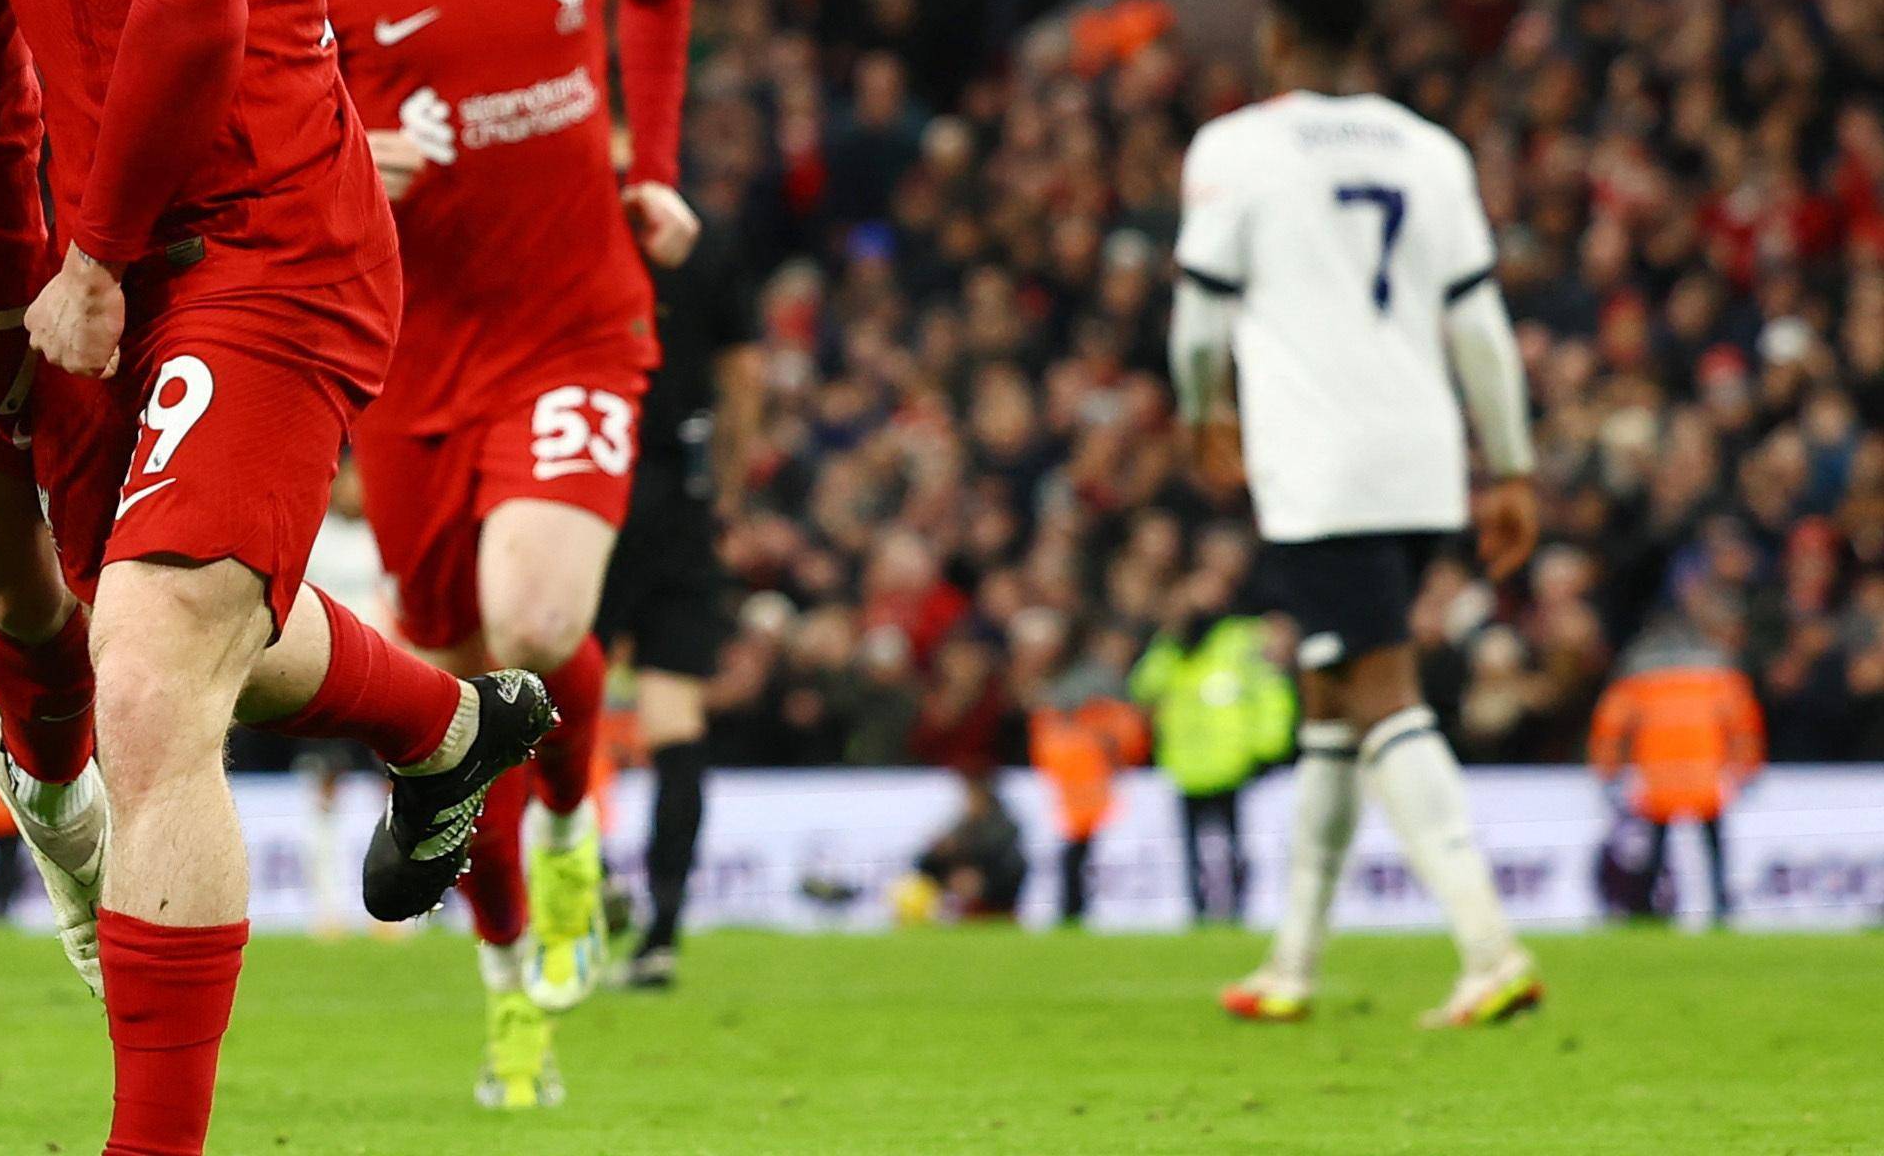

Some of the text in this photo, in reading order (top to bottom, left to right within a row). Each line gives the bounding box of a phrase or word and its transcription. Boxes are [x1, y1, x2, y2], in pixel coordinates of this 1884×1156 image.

[1333, 185, 1406, 311] 7
[124, 355, 214, 486] 9
[529, 384, 633, 477] 53
